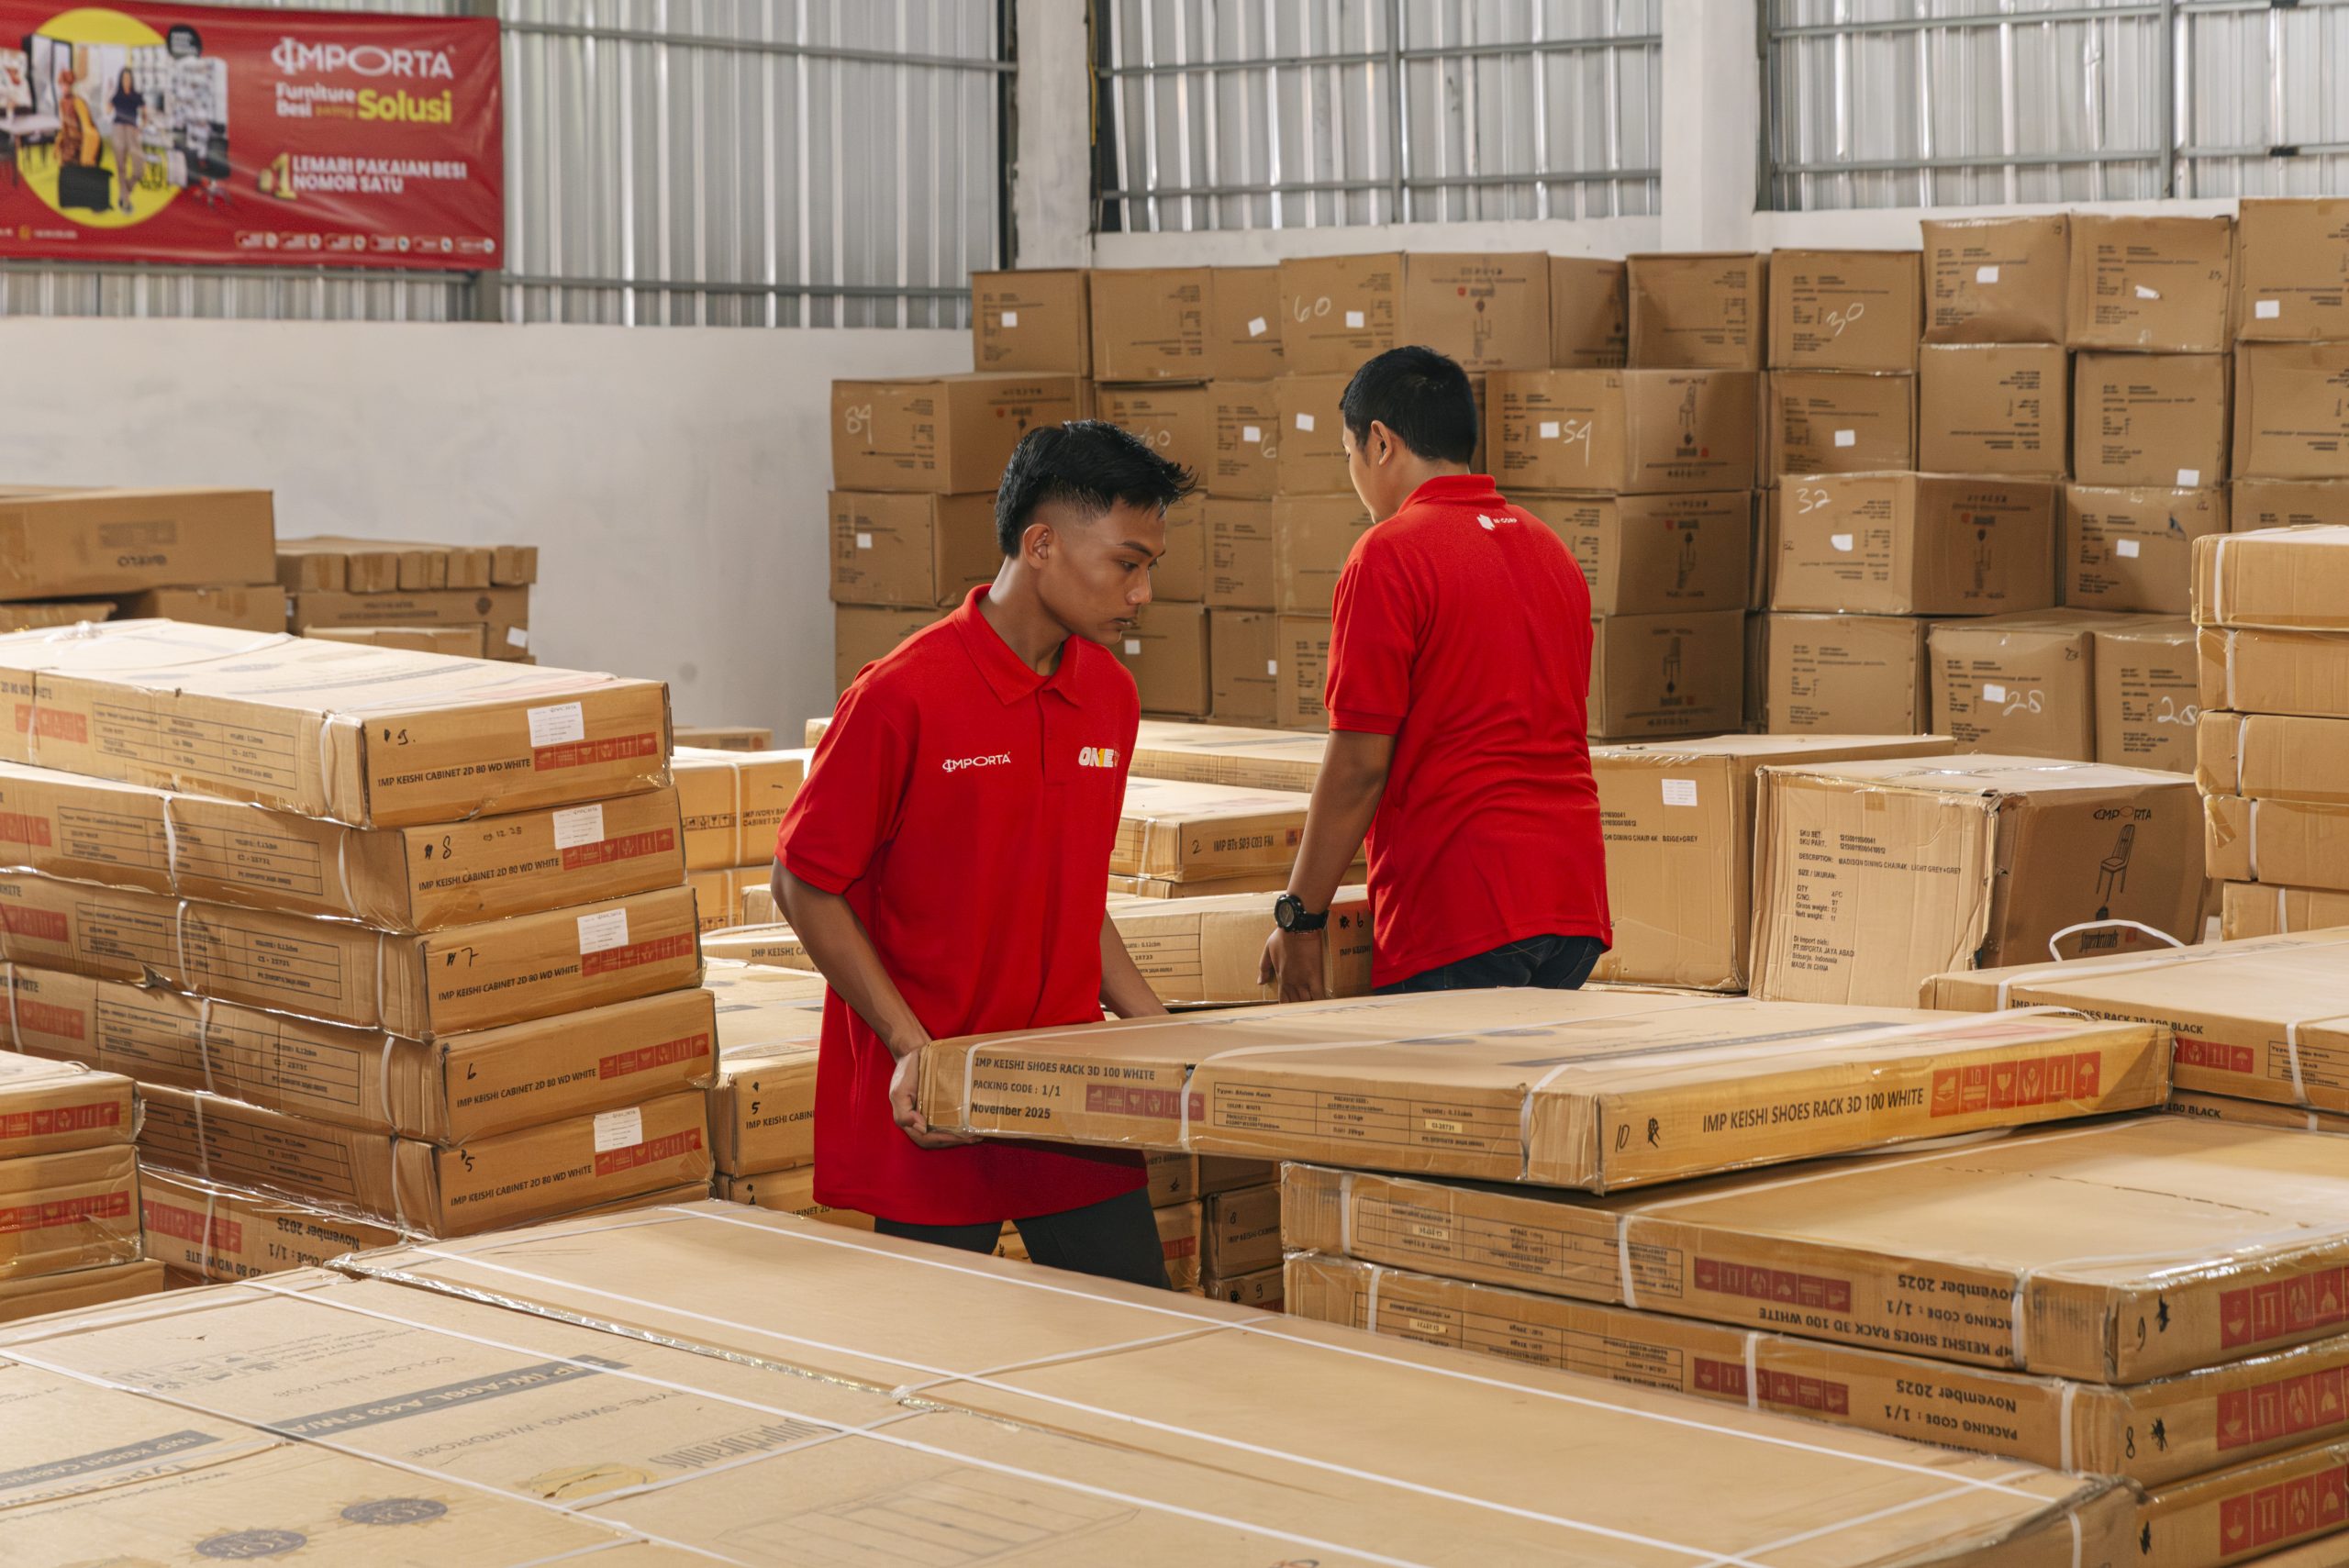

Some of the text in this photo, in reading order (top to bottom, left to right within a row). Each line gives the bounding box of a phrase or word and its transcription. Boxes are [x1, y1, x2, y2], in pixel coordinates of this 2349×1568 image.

[271, 37, 453, 79] IMPORTA
[276, 82, 356, 103] Furniture
[357, 89, 451, 123] Solusi
[293, 155, 467, 179] LEMARI PAKAIAN BESI
[293, 175, 404, 194] NOMOR SATU
[1294, 295, 1331, 325] 60
[1826, 303, 1864, 336] 30
[1796, 487, 1832, 515] 32
[378, 777, 395, 787] IMP
[396, 773, 423, 785] KEISHI
[426, 769, 461, 782] CABINET
[462, 767, 474, 776] 2D
[488, 763, 503, 773] WD
[505, 758, 530, 770] WHITE
[942, 753, 1011, 773] IMPORTA
[1214, 840, 1227, 852] IMP
[418, 881, 434, 891] IMP
[436, 877, 461, 889] KEISHI
[462, 870, 495, 884] CABINET
[496, 868, 507, 878] 2D
[519, 862, 533, 873] WD
[535, 857, 559, 870] WHITE
[1864, 860, 1883, 868] DINING
[751, 948, 765, 958] IMP
[768, 947, 795, 957] KEISHI
[1791, 962, 1806, 970] MADE
[439, 990, 454, 1001] IMP
[456, 984, 482, 998] KEISHI
[483, 978, 515, 994] CABINET
[517, 974, 528, 985] 2D
[539, 969, 553, 981] WD
[554, 964, 579, 978] WHITE
[2011, 999, 2030, 1010] IMP
[2104, 1012, 2131, 1024] RACK
[2171, 1021, 2203, 1035] BLACK
[975, 1057, 1155, 1080] IMP KEISHI SHOES RACK 3D 100 WHITE
[457, 1097, 472, 1107] IMP
[474, 1093, 499, 1106] KEISHI
[500, 1083, 533, 1098] CABINET
[535, 1081, 545, 1090] 2D
[557, 1074, 571, 1086] WD
[572, 1068, 596, 1082] WHITE
[973, 1080, 1061, 1097] PACKING CODE 1/1
[746, 1115, 787, 1129] IMP KEISHI
[751, 1102, 761, 1115] 5
[971, 1102, 1051, 1119] November 2025
[1703, 1087, 1924, 1133] IMP KEISHI SHOES RACK 3D 100 WHITE
[2188, 1105, 2221, 1118] BLACK
[451, 1195, 467, 1207] IMP
[469, 1189, 495, 1203] KEISHI
[495, 1181, 529, 1196] CABINET
[529, 1178, 540, 1188] 2D
[552, 1172, 567, 1183] WD
[568, 1164, 593, 1178] WHITE
[277, 1217, 360, 1251] November 2025
[269, 1242, 287, 1261] 1/1
[1898, 1273, 1935, 1293] 2025
[1887, 1299, 1961, 1322] CODE 1/1
[1759, 1307, 1990, 1355] KEISHI SHOES RACK 3D 100 WHITE
[1896, 1379, 2016, 1413] November 2025
[541, 1403, 619, 1429] SWING
[1884, 1405, 2018, 1440] PACKING CODE 1/1
[78, 1434, 195, 1466] IMP KEISHI
[410, 1422, 539, 1458] WARDROBE
[2126, 1426, 2135, 1460] 8
